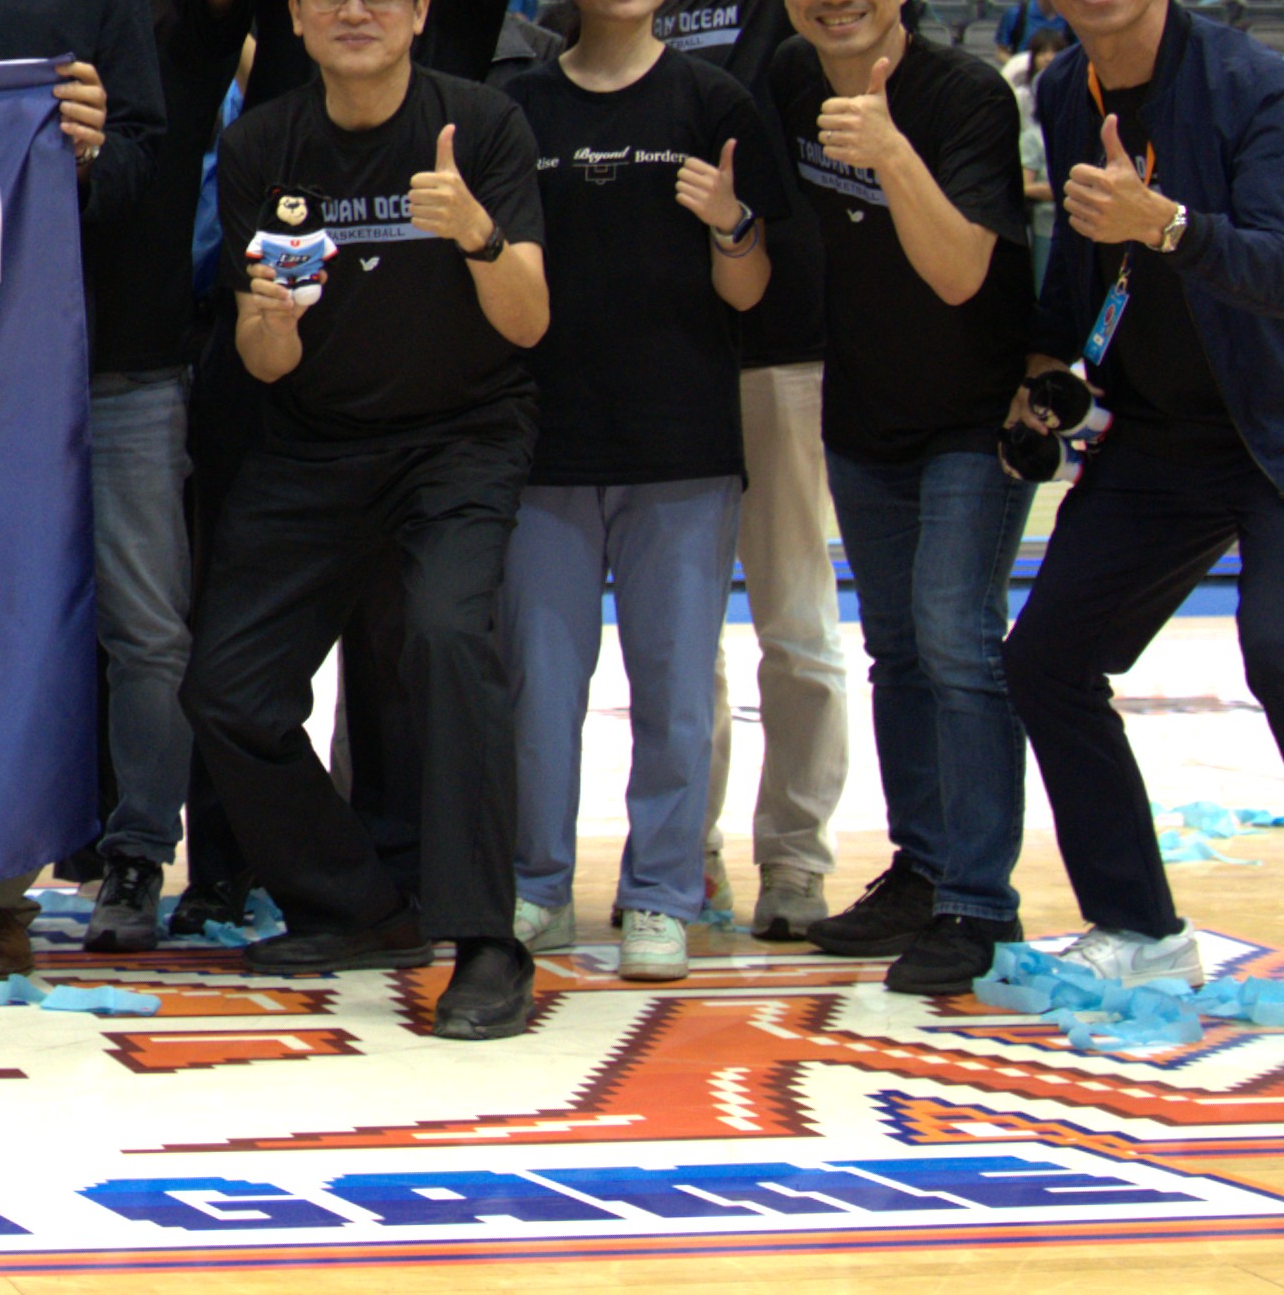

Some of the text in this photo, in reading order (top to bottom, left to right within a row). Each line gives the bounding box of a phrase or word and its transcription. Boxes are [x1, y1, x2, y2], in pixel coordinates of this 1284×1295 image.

[678, 5, 738, 33] OCEAN
[573, 144, 632, 164] Beyond
[321, 194, 412, 223] WAN OCE
[75, 1154, 1208, 1233] GAME
